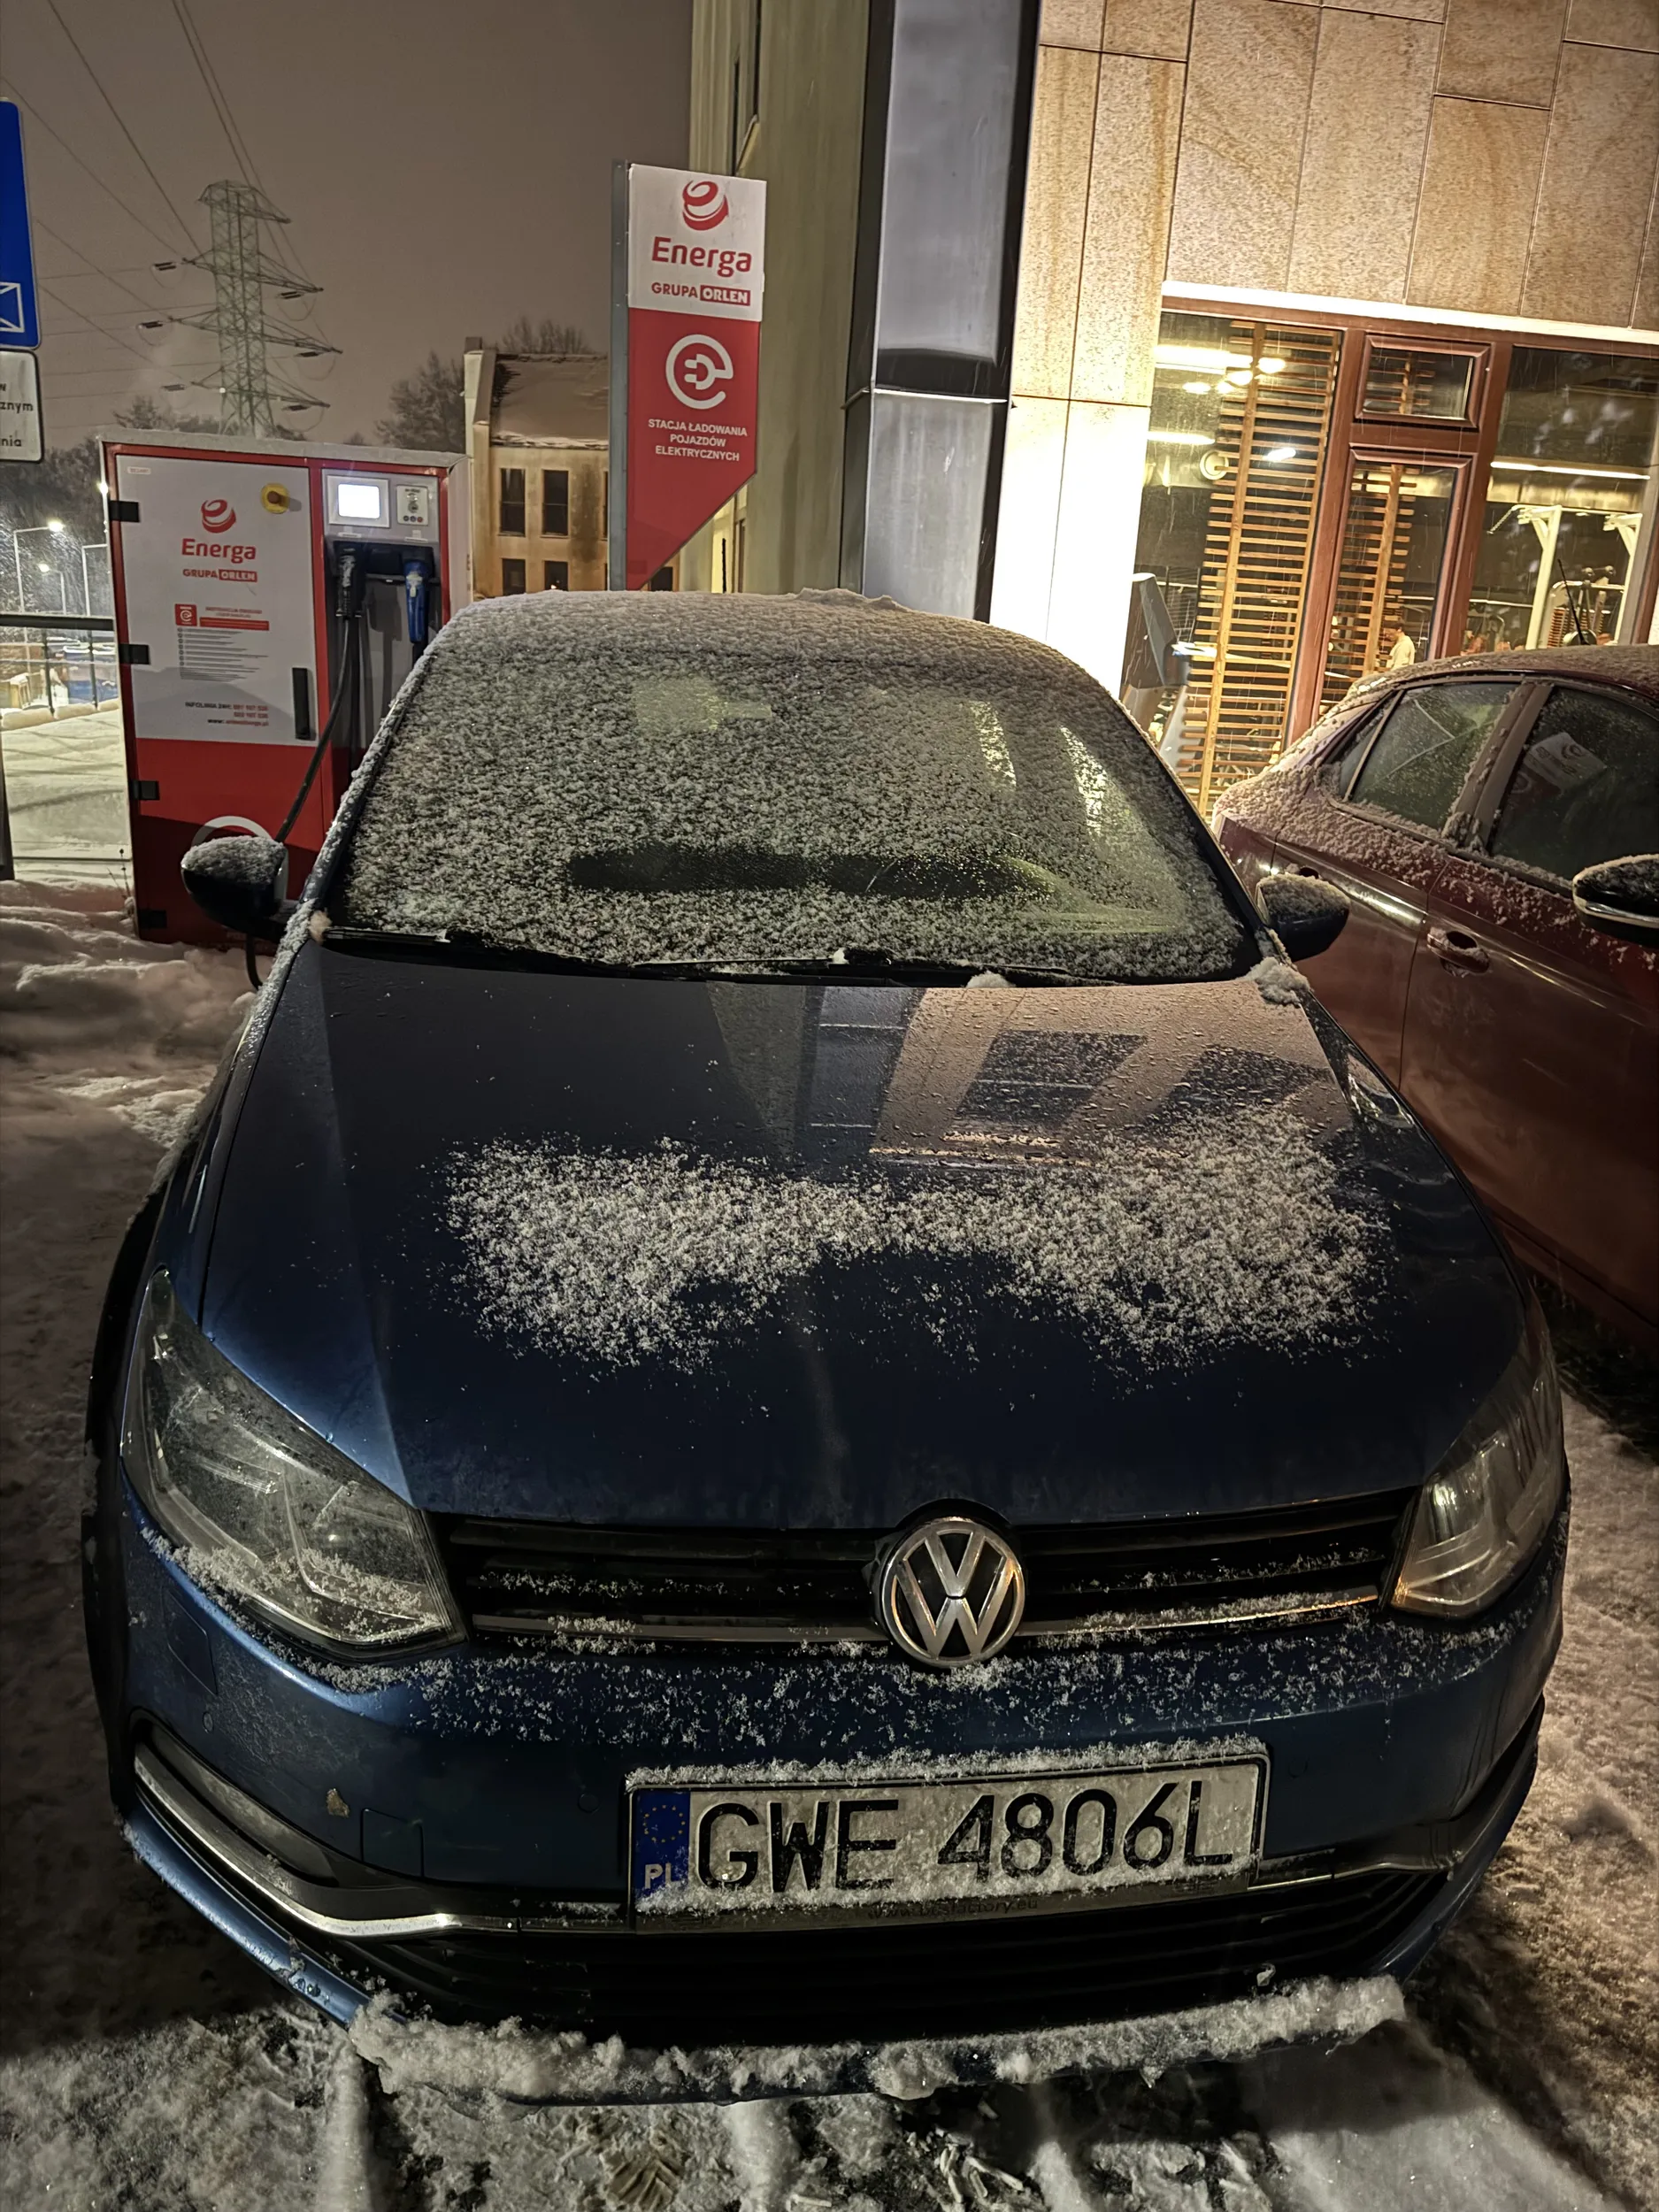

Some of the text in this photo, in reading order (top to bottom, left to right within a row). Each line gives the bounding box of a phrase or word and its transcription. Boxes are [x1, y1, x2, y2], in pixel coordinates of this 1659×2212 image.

[651, 236, 752, 278] Energa
[651, 281, 749, 304] GRUPA ORLEN
[648, 419, 748, 436] STACJA ŁADOWANIA
[670, 434, 726, 447] POJAZDÓW
[655, 445, 740, 462] ELEKTRYCZNYCH
[181, 538, 257, 564] Energa
[182, 568, 256, 581] GRUPA ORLEN
[696, 1780, 1234, 1893] GWE 4806L
[644, 1862, 684, 1889] PL
